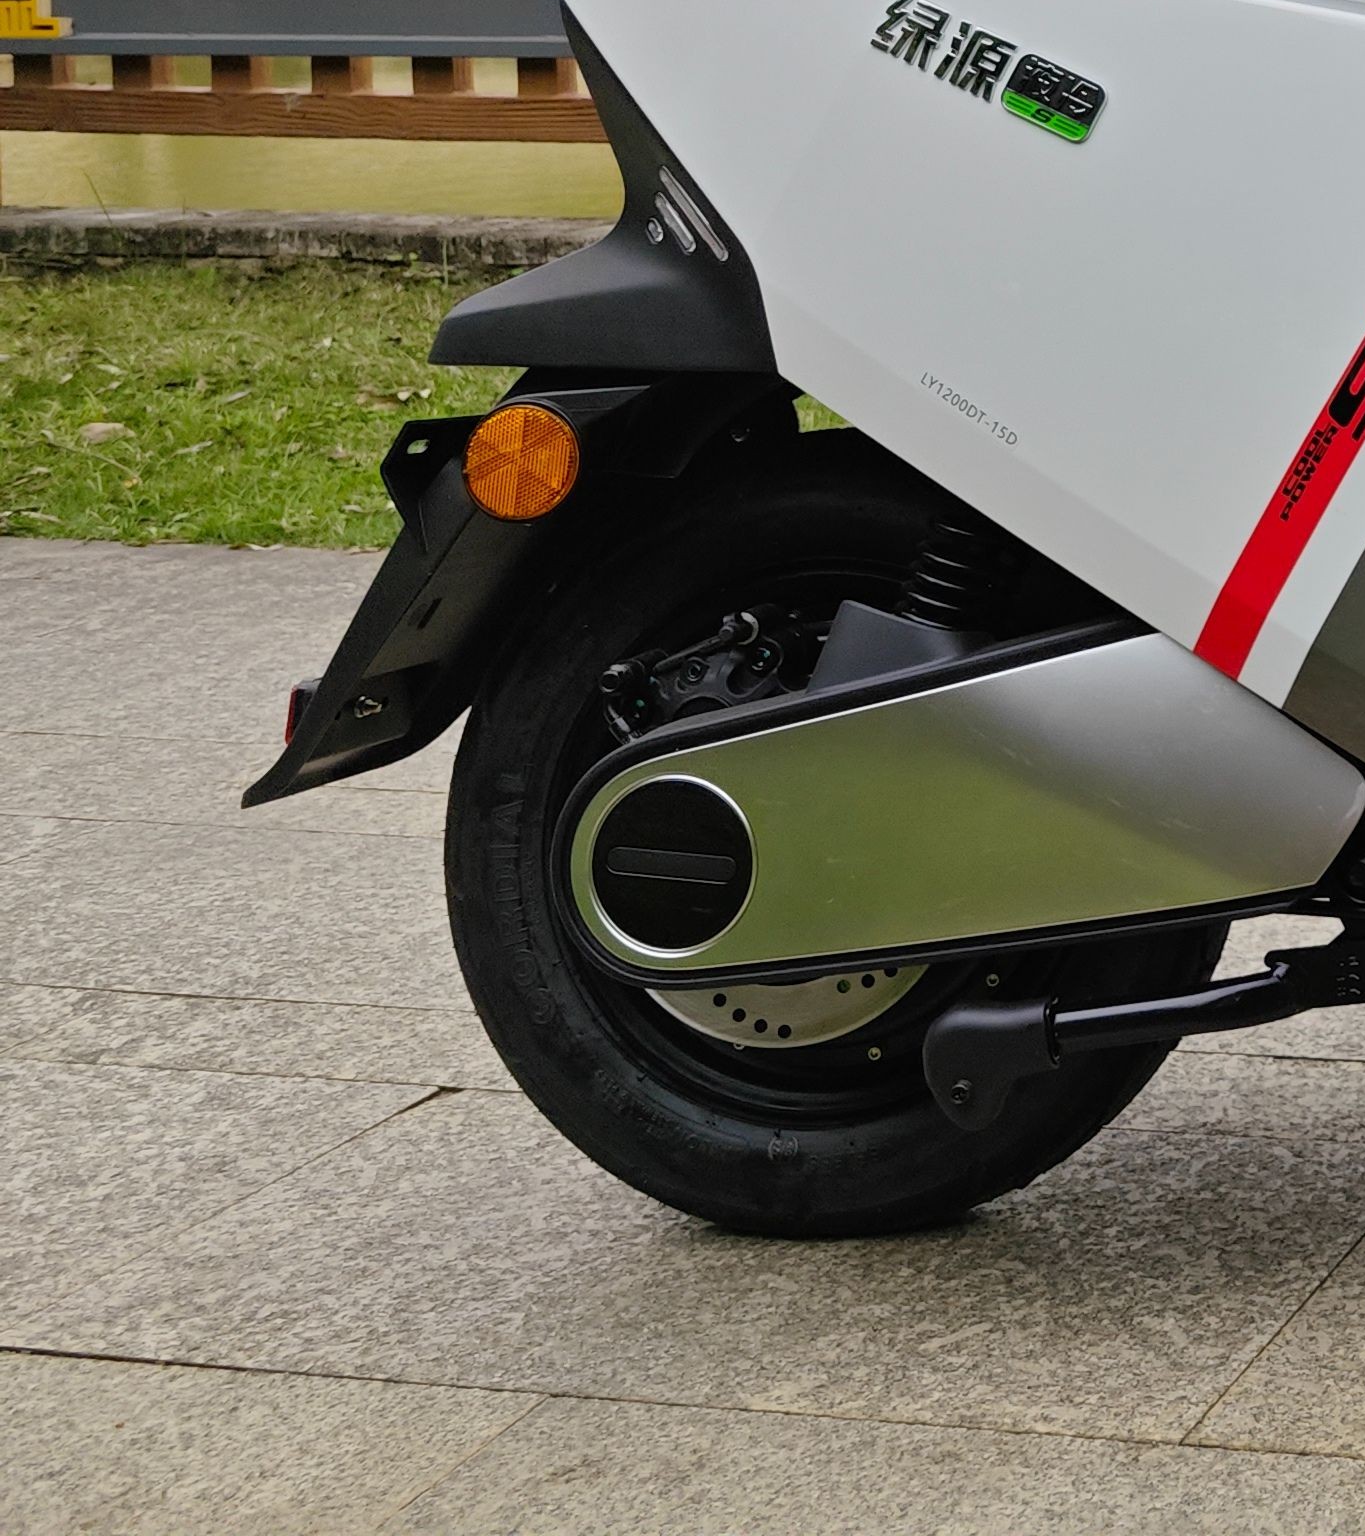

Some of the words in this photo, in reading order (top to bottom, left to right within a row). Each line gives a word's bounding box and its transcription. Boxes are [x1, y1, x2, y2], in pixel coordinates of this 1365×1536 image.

[920, 371, 1019, 446] LY1200DT-15D
[1280, 425, 1338, 522] POWER
[1282, 422, 1332, 497] COOL
